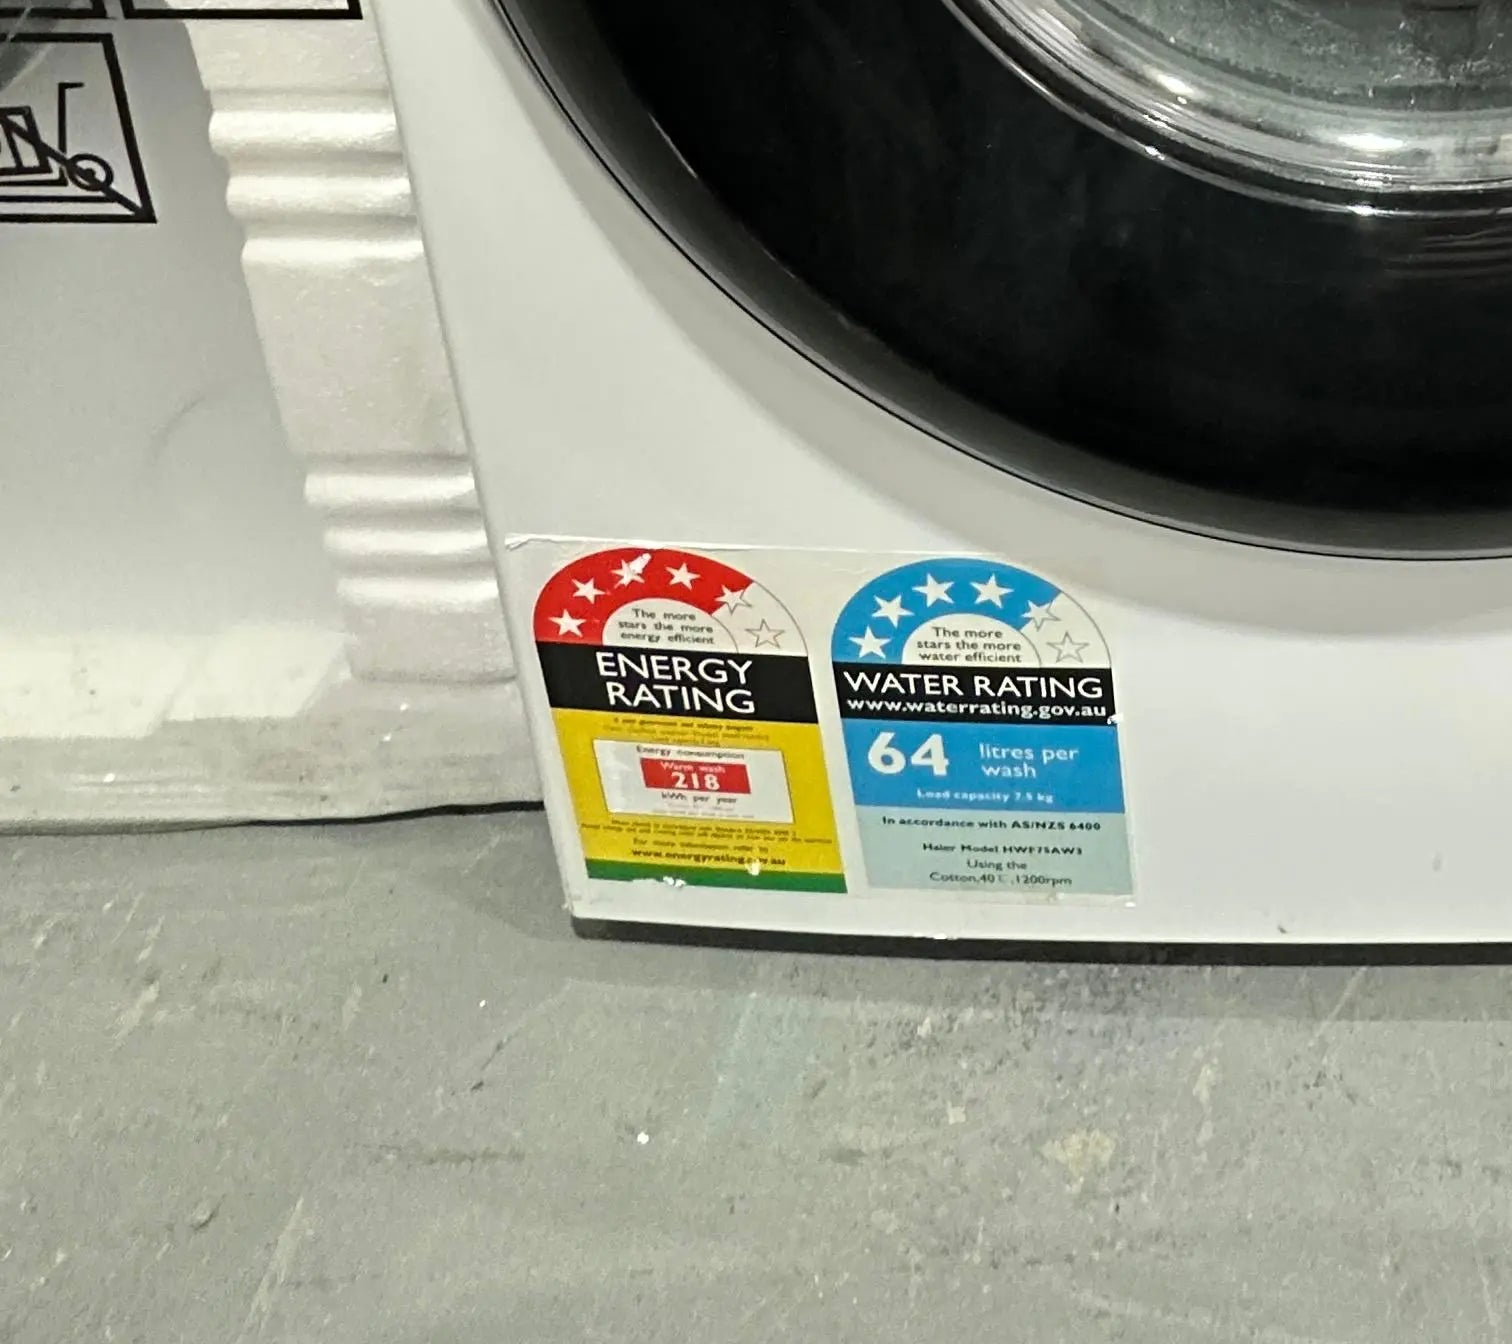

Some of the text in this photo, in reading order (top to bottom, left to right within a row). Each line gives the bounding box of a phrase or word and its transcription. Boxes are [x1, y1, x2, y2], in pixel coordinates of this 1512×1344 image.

[632, 608, 696, 621] The more
[619, 620, 713, 633] stars the more
[932, 627, 1002, 638] The more
[621, 633, 714, 644] energy efficient
[917, 640, 1021, 651] stars the more
[919, 652, 1021, 663] water efficient
[596, 652, 752, 684] ENERGY
[843, 671, 1102, 698] WATER RATING
[606, 681, 755, 713] RATING
[848, 699, 1106, 719] www.waterrating.gov.au
[636, 745, 671, 757] Energy
[868, 732, 949, 776] 64
[979, 743, 1079, 765] litres per
[982, 763, 1036, 778] wash
[672, 772, 720, 790] 218
[693, 794, 710, 803] per
[717, 796, 737, 805] year
[883, 816, 895, 825] In
[899, 817, 974, 828] accordance
[977, 819, 1006, 829] with
[1069, 821, 1100, 831] 6400
[961, 844, 998, 853] Model
[967, 859, 1027, 871] Using the
